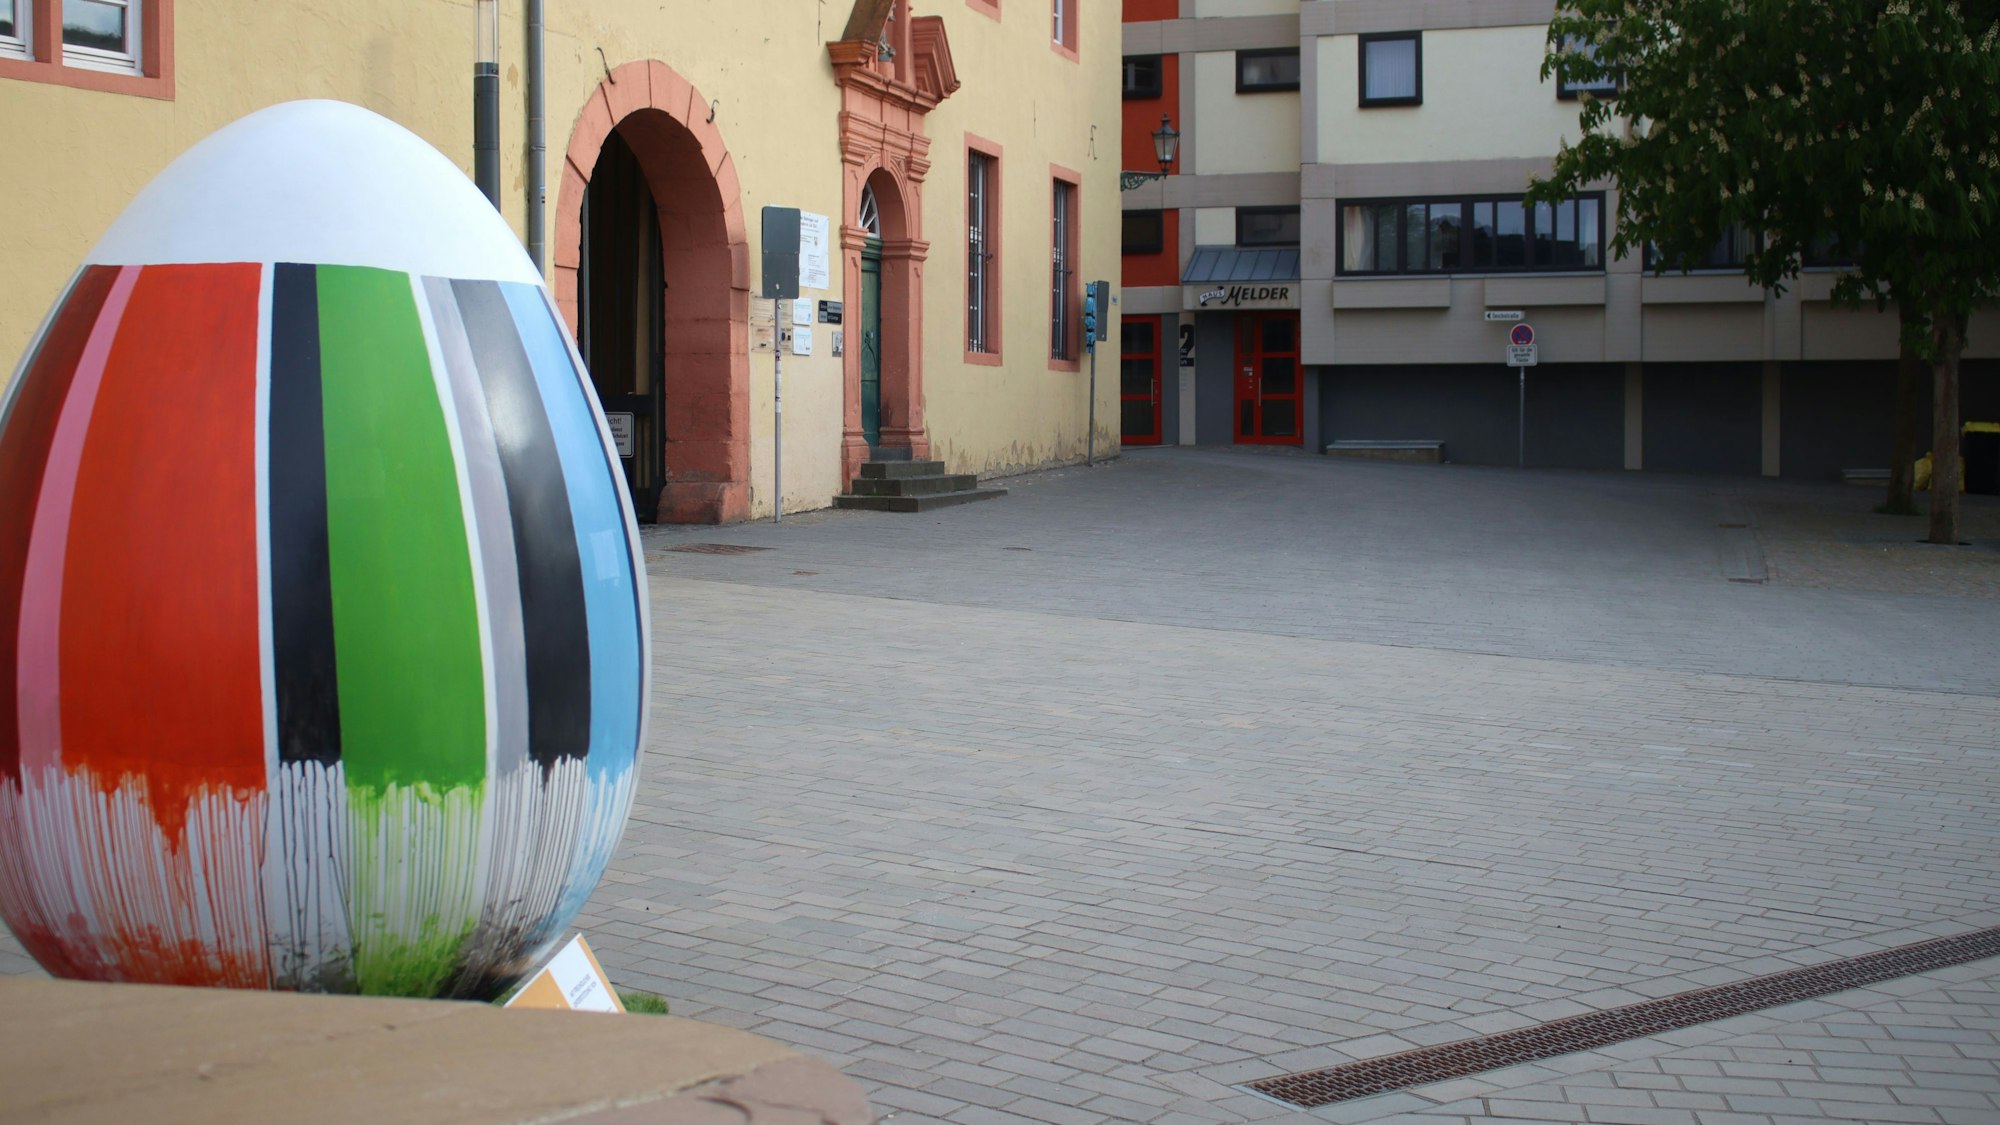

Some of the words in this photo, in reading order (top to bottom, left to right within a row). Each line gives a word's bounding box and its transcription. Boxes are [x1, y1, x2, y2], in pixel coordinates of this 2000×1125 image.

[1221, 285, 1290, 306] MELDER
[1180, 324, 1195, 367] 2
[607, 417, 622, 425] icht!
